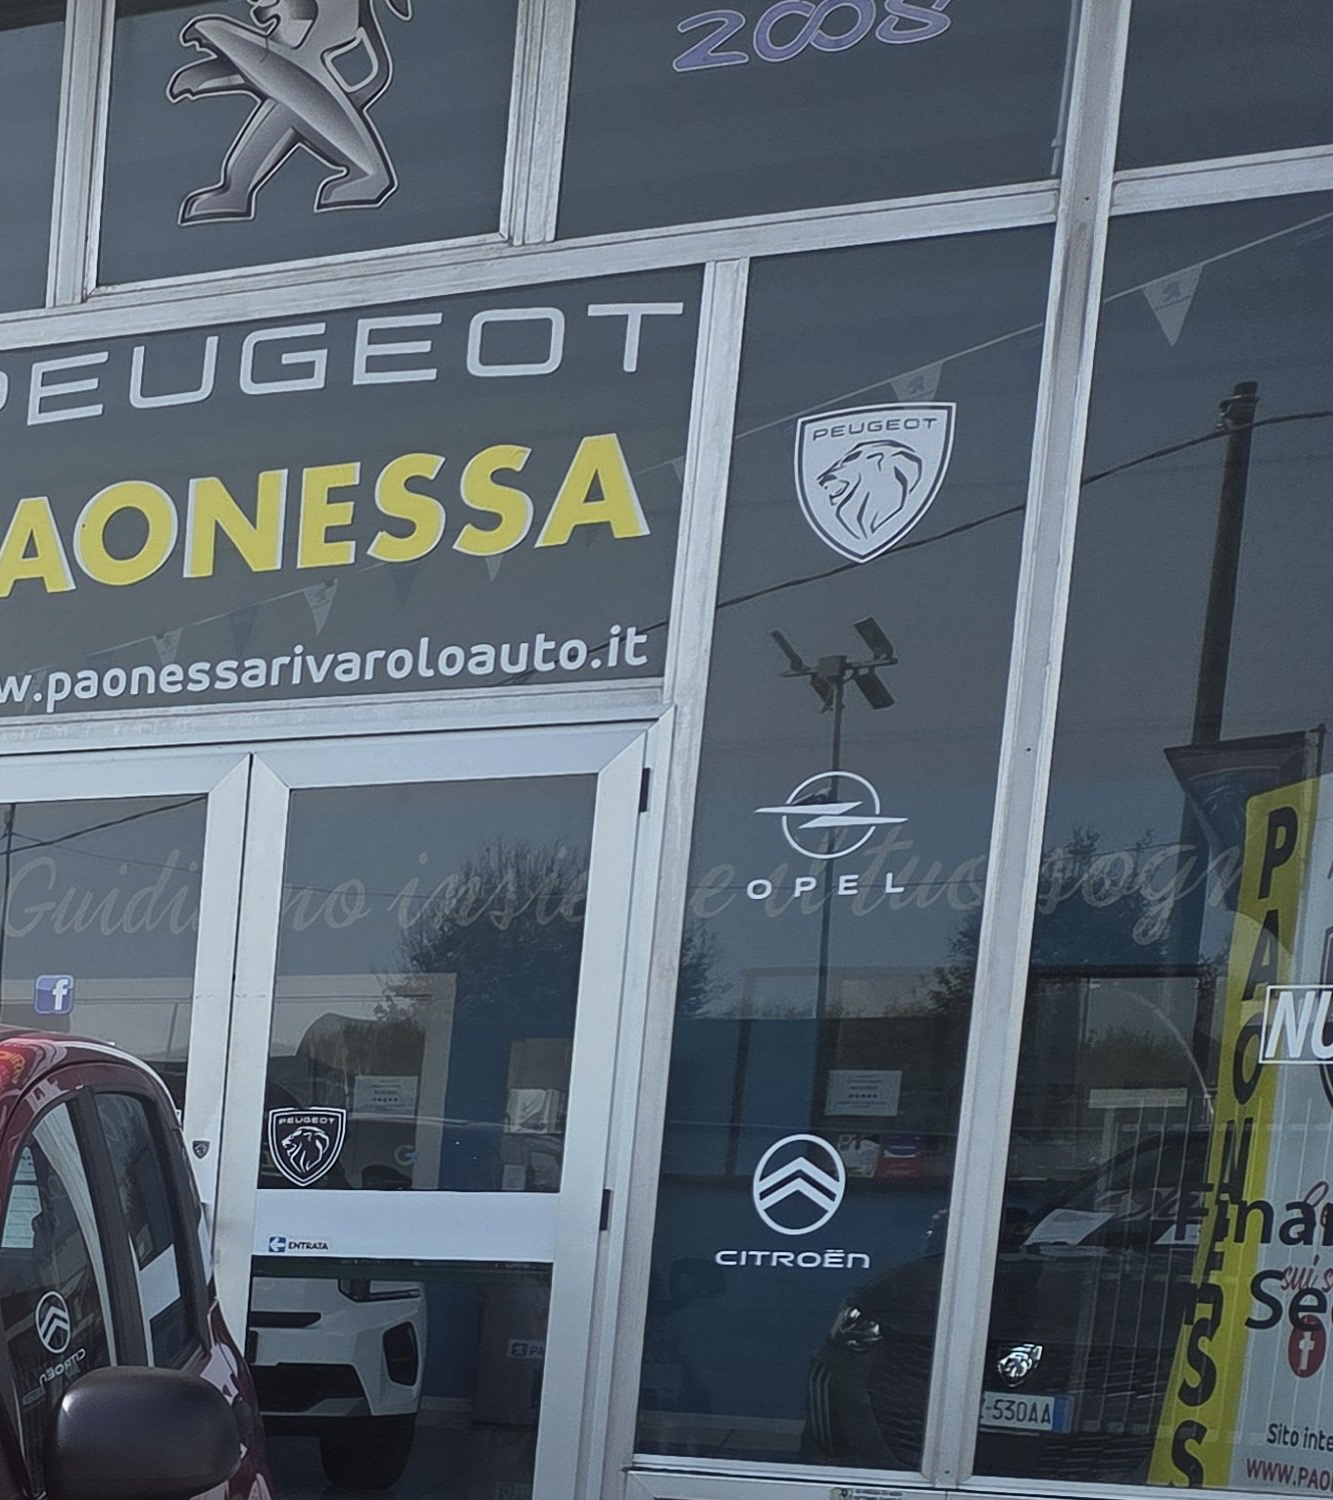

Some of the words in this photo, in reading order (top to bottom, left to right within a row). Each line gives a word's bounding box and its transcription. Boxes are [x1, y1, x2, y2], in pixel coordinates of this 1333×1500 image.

[811, 415, 939, 442] PEUGEOT
[746, 872, 906, 901] OPEL
[278, 1116, 336, 1126] PEUGEOT
[287, 1240, 329, 1251] ENTRATA
[1266, 1422, 1300, 1448] Sito
[1246, 1457, 1333, 1492] WWW.PAO
